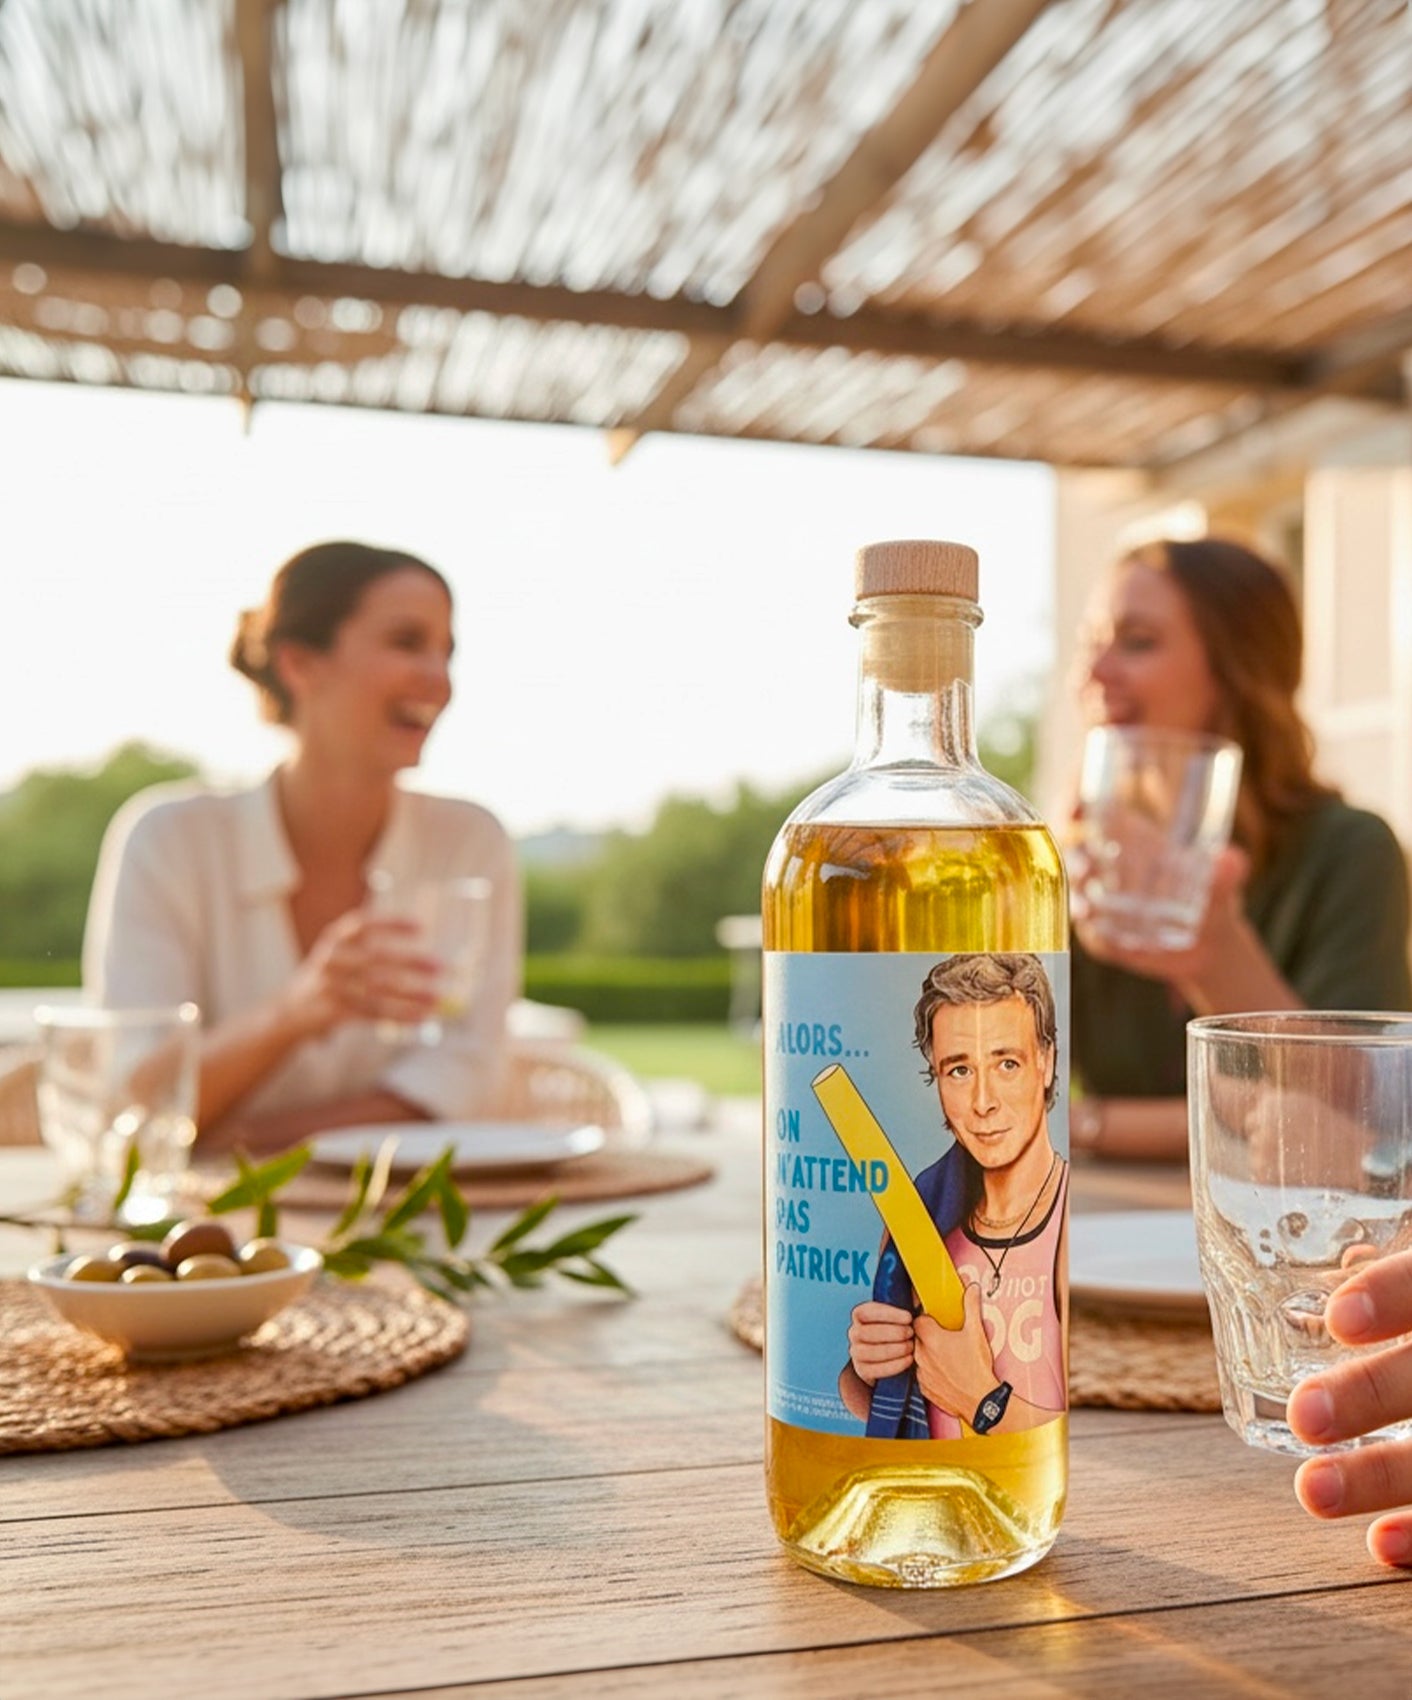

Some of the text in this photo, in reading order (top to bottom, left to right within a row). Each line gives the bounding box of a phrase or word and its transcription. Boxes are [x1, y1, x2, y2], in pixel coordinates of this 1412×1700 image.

[776, 1107, 800, 1142] ON
[776, 1196, 810, 1234] PAS
[776, 1239, 871, 1286] PATRICK
